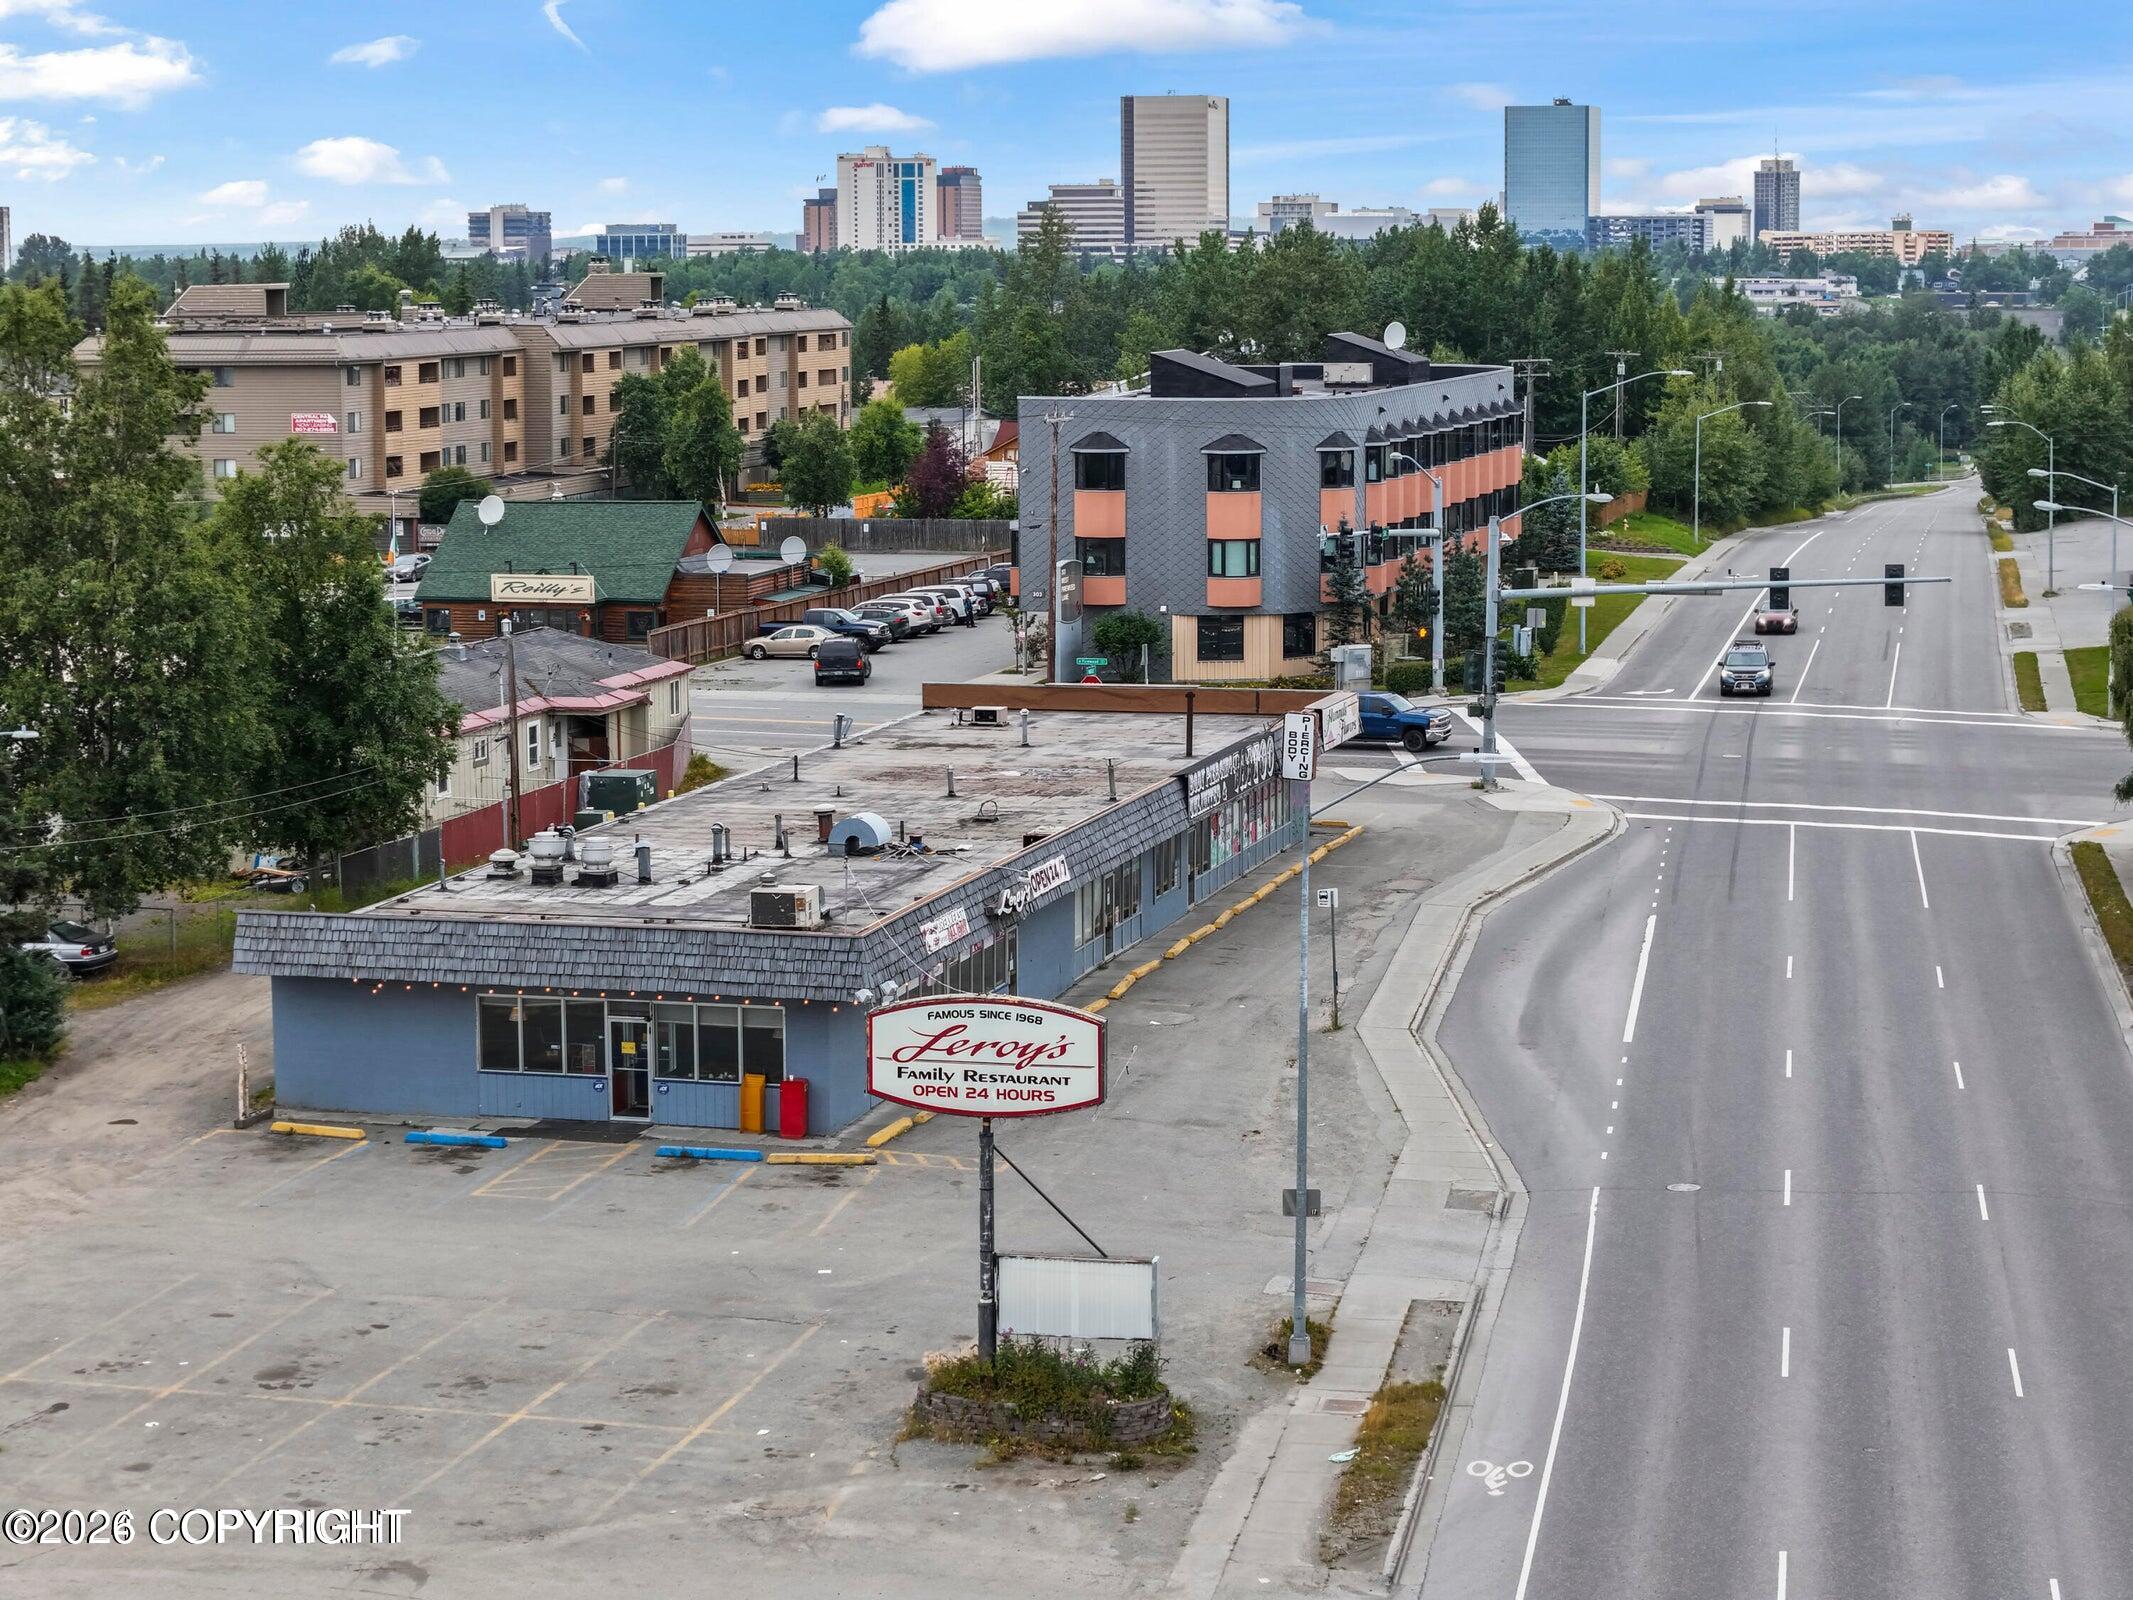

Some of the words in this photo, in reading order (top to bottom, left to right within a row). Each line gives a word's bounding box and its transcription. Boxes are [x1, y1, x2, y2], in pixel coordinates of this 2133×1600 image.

[500, 581, 586, 597] Reilly's
[1287, 731, 1298, 762] BODY
[1299, 716, 1311, 779] PIERCING
[1030, 868, 1052, 893] OPEN
[1049, 858, 1067, 880] 24/7
[927, 1009, 975, 1020] FAMOUS
[979, 1010, 1011, 1020] SINCE
[1015, 1013, 1043, 1025] 1968
[892, 1024, 1075, 1070] Leroy's
[913, 1085, 958, 1098] OPEN
[965, 1087, 989, 1100] 24
[996, 1088, 1056, 1102] HOURS
